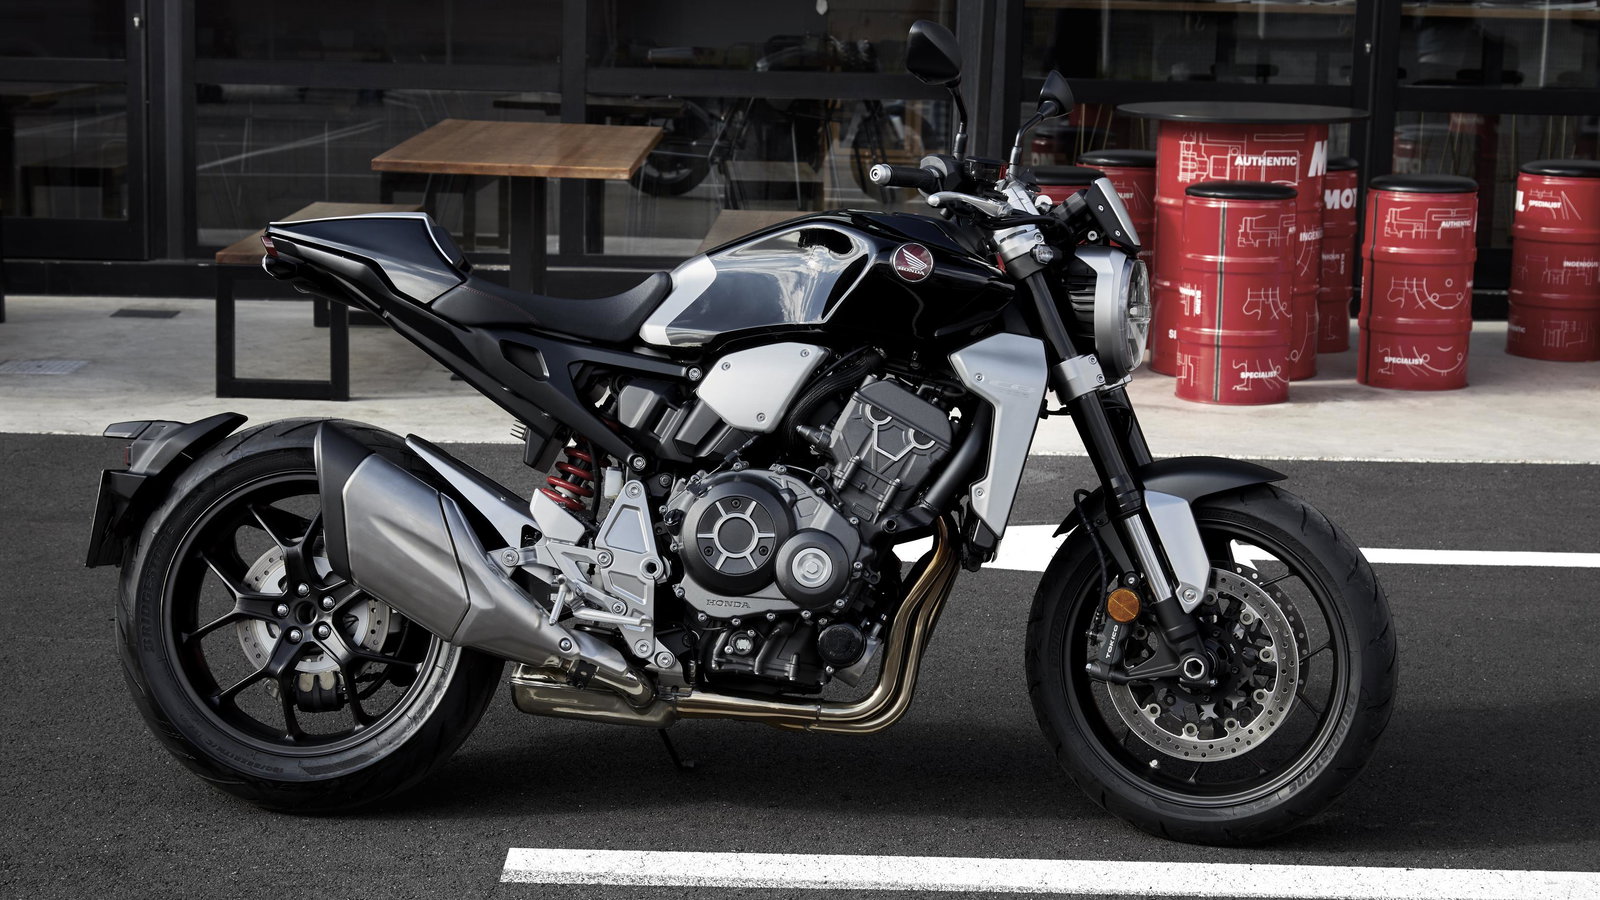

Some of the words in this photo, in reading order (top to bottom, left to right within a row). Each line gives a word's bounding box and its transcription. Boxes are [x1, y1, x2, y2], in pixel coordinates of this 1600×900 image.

[1234, 155, 1297, 167] AUTHENTIC
[1528, 199, 1562, 209] SPECIALIST
[1440, 219, 1472, 229] AUTHENTIC
[1563, 260, 1599, 268] INGENIOUS
[897, 265, 926, 276] HONDA
[1384, 356, 1424, 366] SPECIALIST
[1240, 371, 1278, 380] SPECIALIST
[706, 598, 751, 609] HONDA
[1105, 624, 1119, 660] TOKICO
